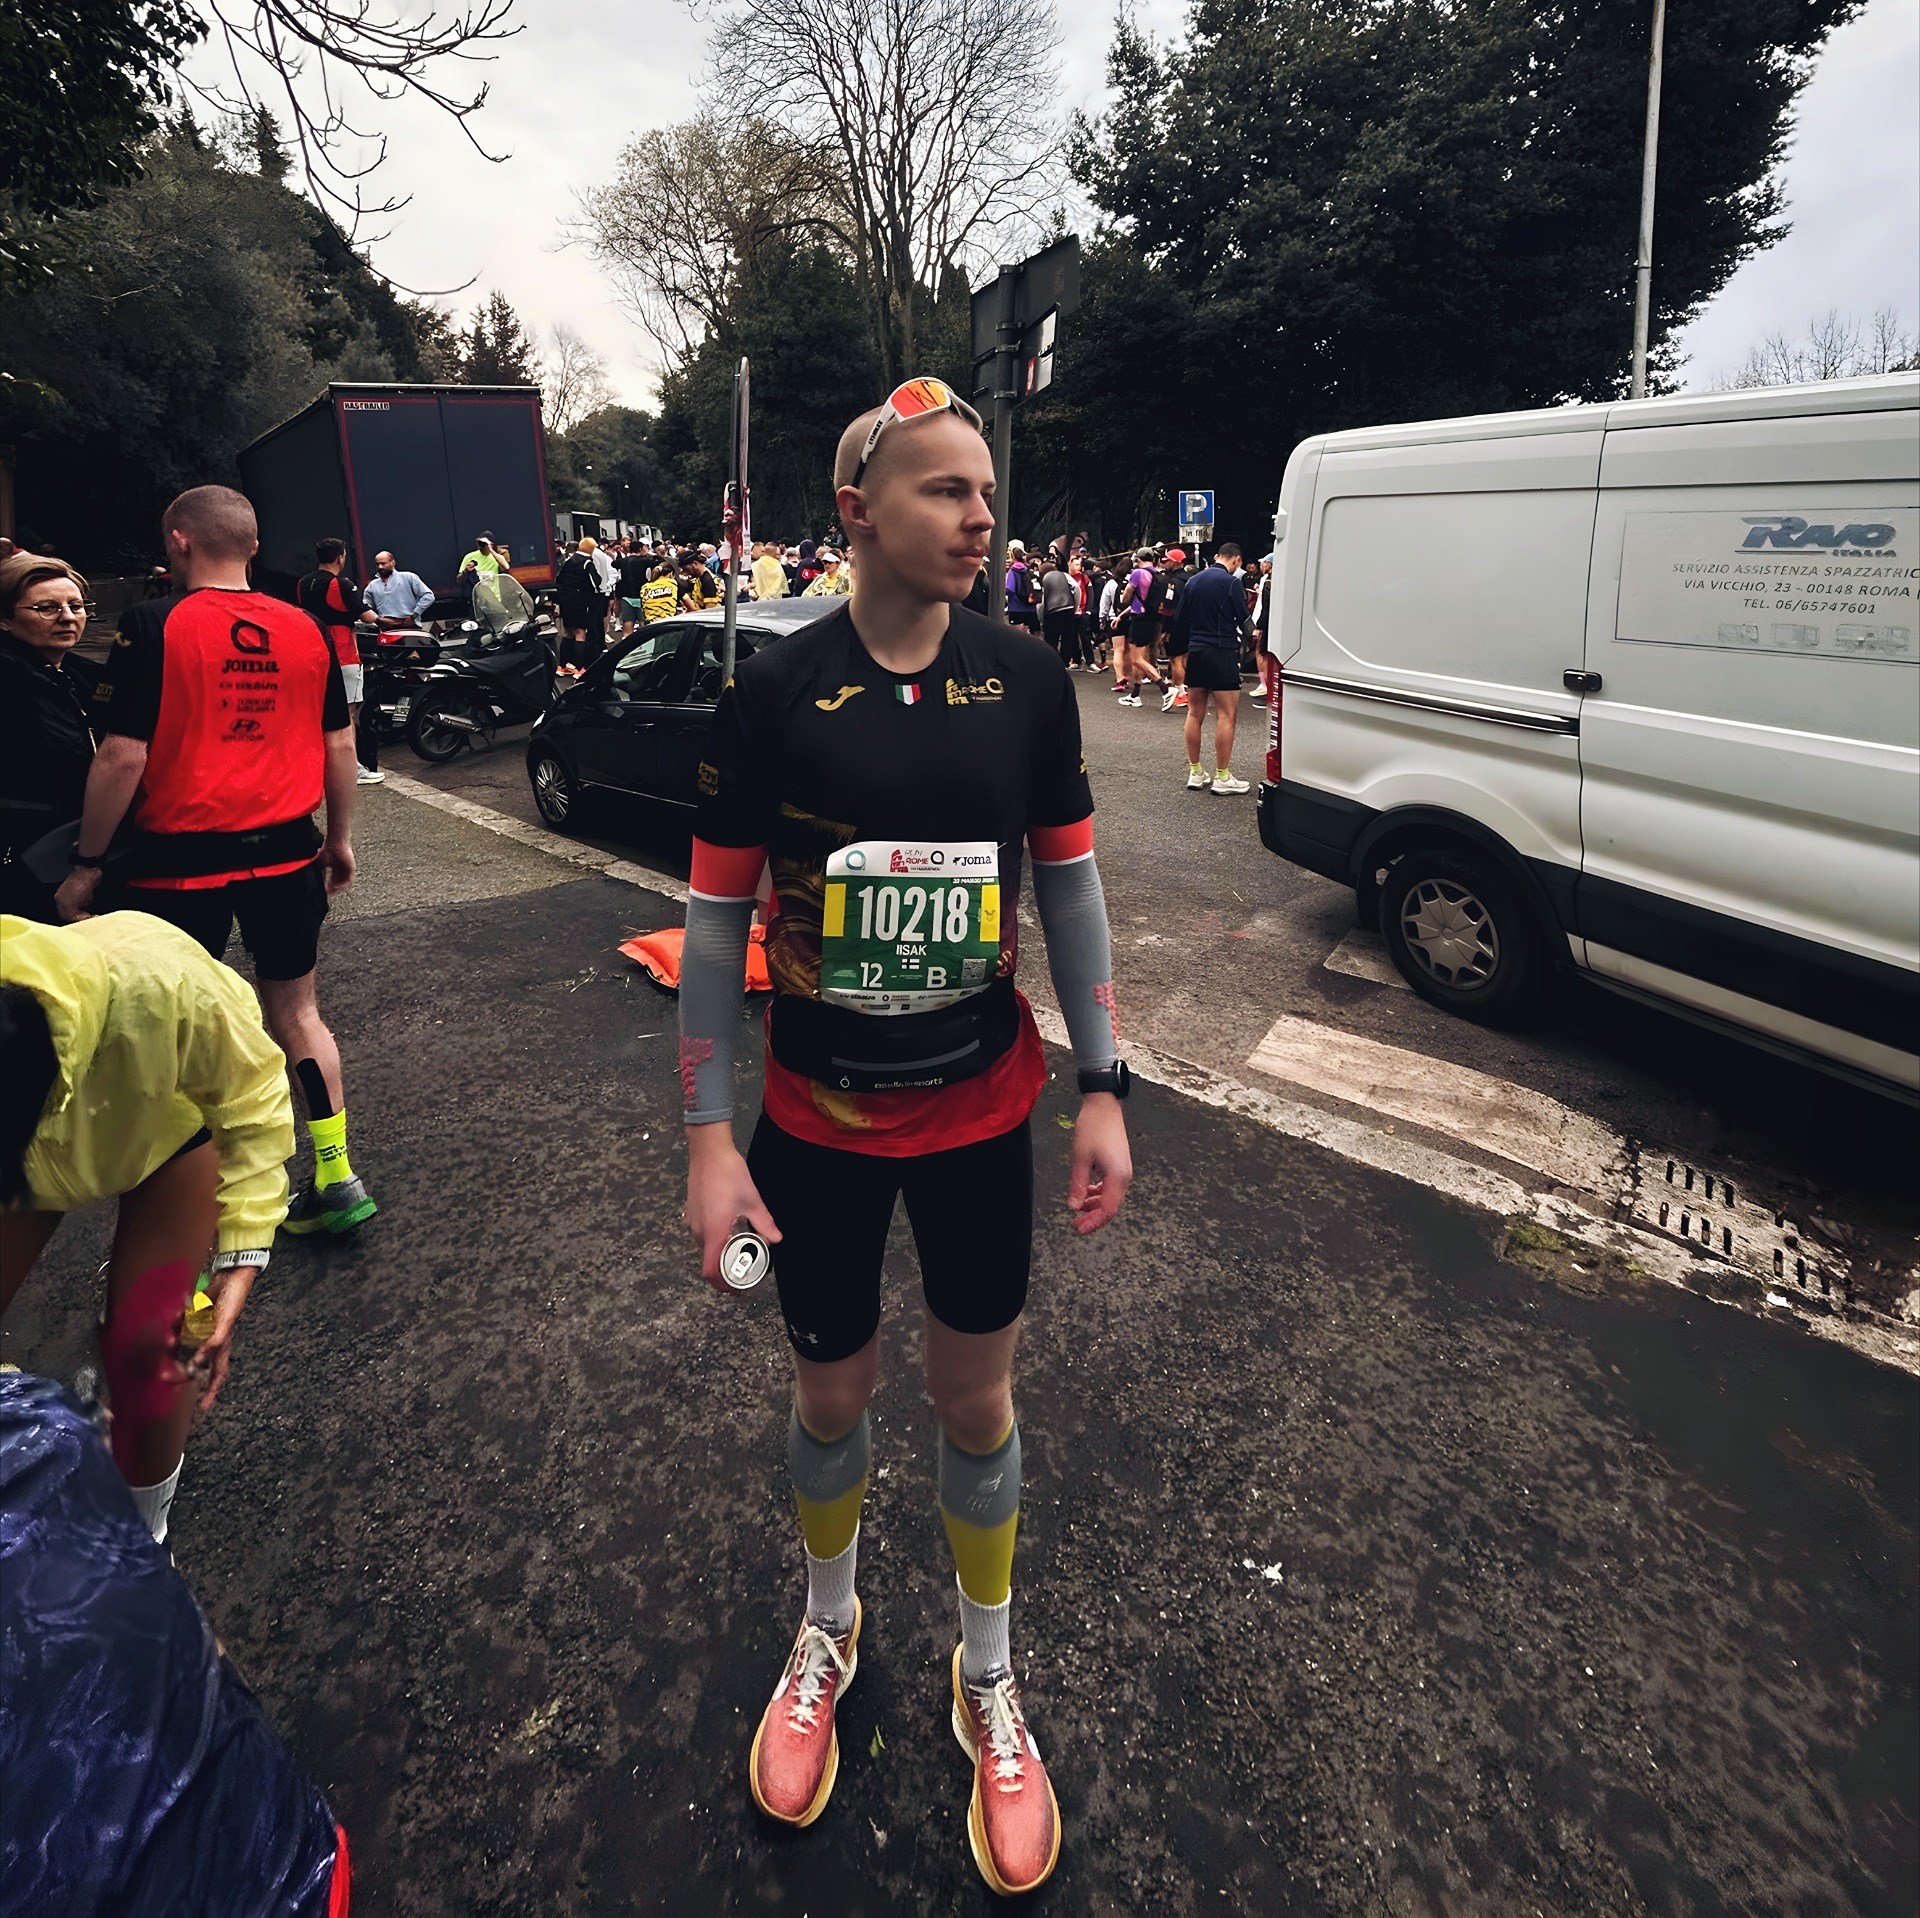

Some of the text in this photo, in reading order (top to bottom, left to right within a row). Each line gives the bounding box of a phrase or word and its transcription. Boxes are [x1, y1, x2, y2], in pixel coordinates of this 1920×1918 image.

[1186, 494, 1207, 522] P
[1672, 563, 1730, 574] SERVIZIO
[1733, 564, 1818, 576] ASSISTENZA
[1684, 580, 1705, 589] VIA
[1711, 581, 1769, 593] VICCHIO,
[1774, 582, 1792, 593] 23
[1806, 583, 1853, 595] 00148
[1858, 585, 1910, 597] ROMA
[1744, 598, 1876, 614] TEL. 06/65747601
[905, 857, 929, 865] ROME
[858, 886, 969, 943] 10218
[896, 944, 927, 956] IISAK
[860, 962, 883, 988] 12
[926, 966, 947, 988] B
